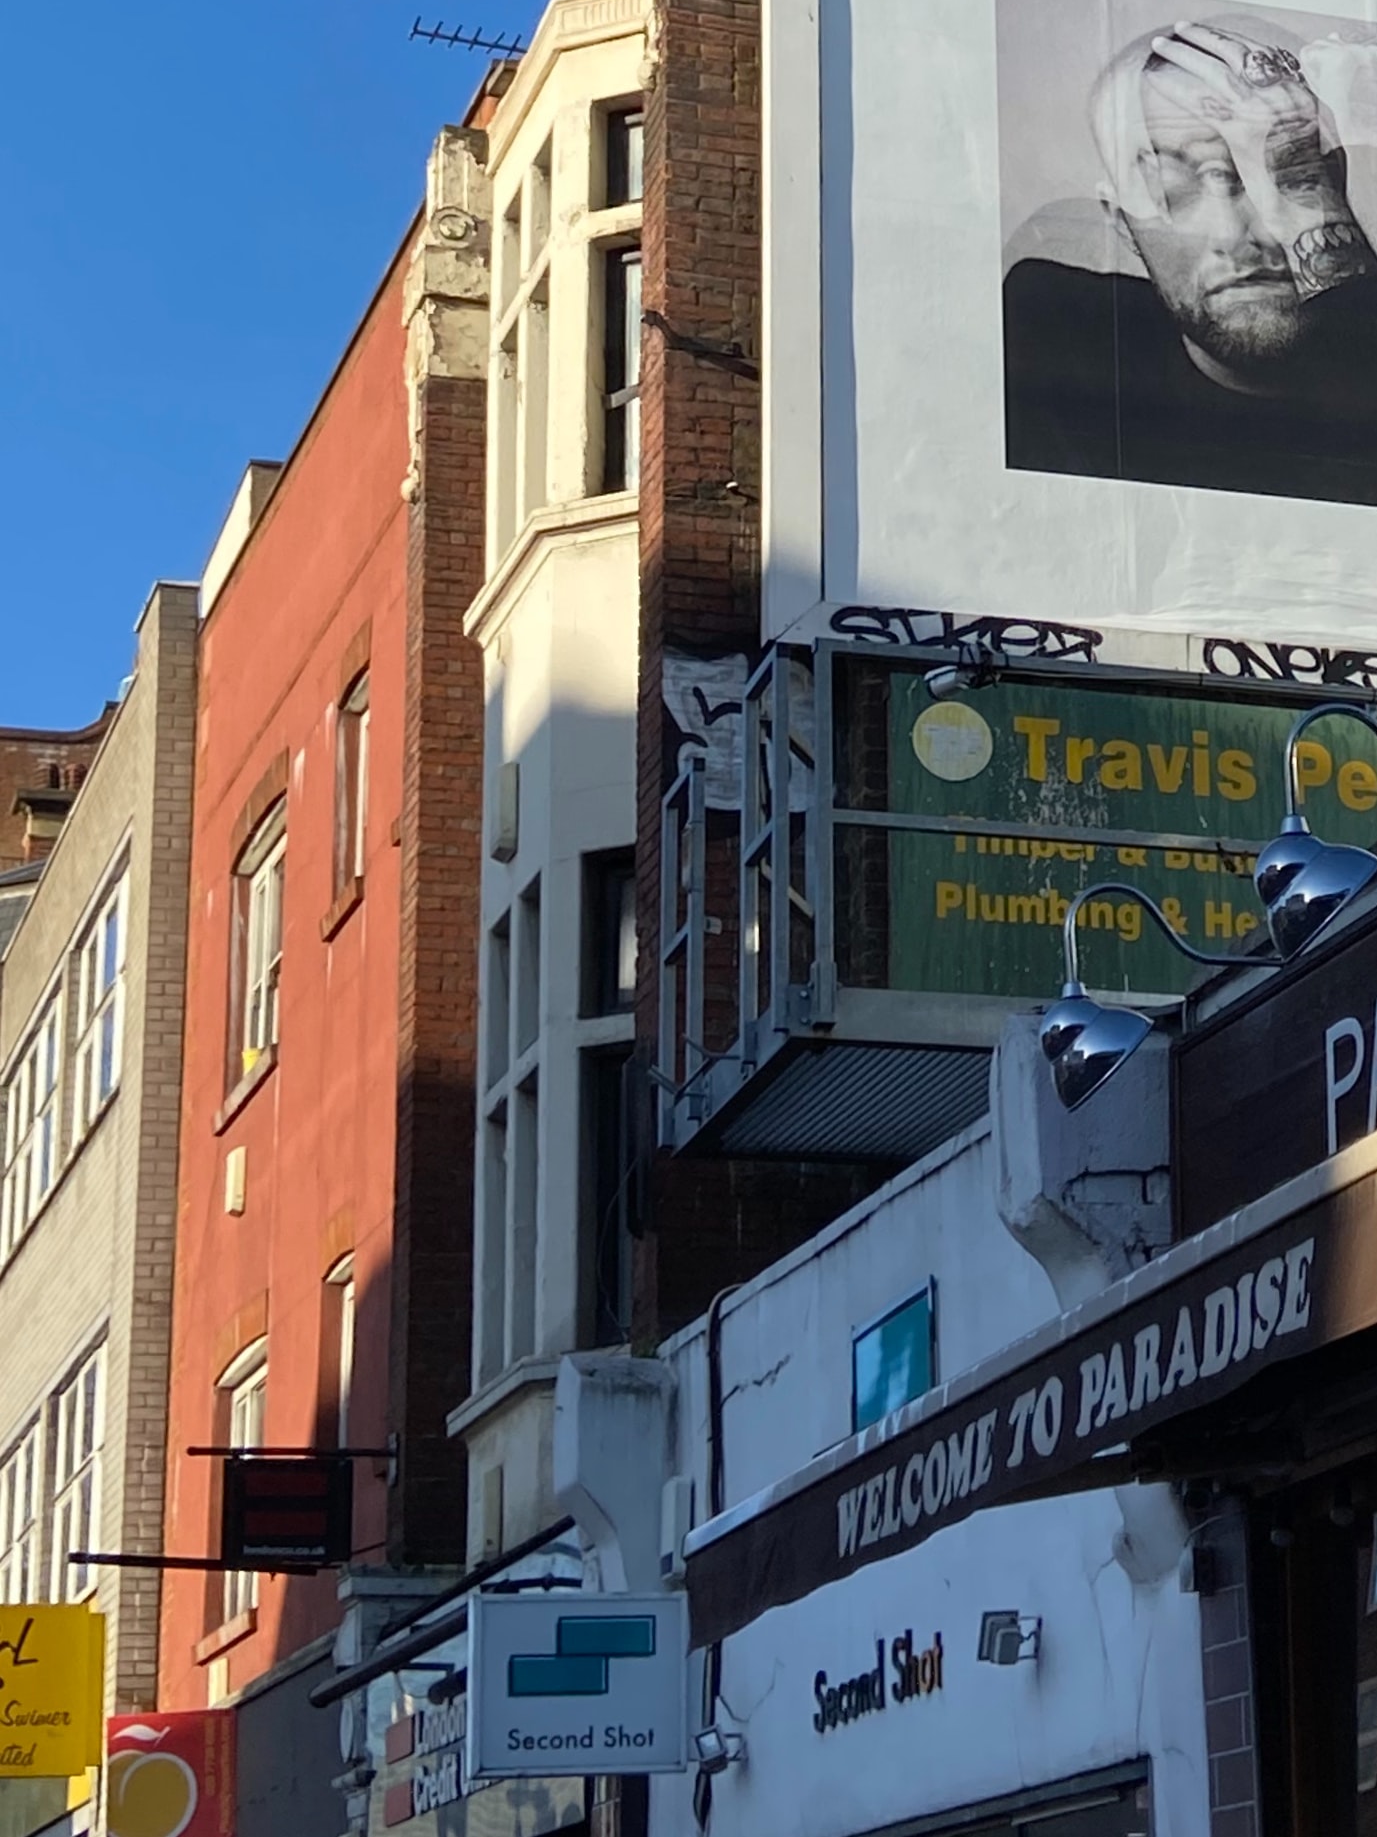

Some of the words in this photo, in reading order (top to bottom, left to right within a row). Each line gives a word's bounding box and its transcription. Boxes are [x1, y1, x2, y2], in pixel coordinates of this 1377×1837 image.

[1014, 716, 1257, 801] Travis
[936, 882, 1142, 941] Plumbing
[1161, 896, 1189, 936] &
[837, 1409, 998, 1558] WELCOME
[1006, 1375, 1064, 1468] TO
[1075, 1237, 1315, 1438] PARADISE
[813, 1637, 886, 1734] Second
[891, 1628, 943, 1704] Shot
[507, 1725, 594, 1751] Second
[603, 1724, 655, 1749] Shot
